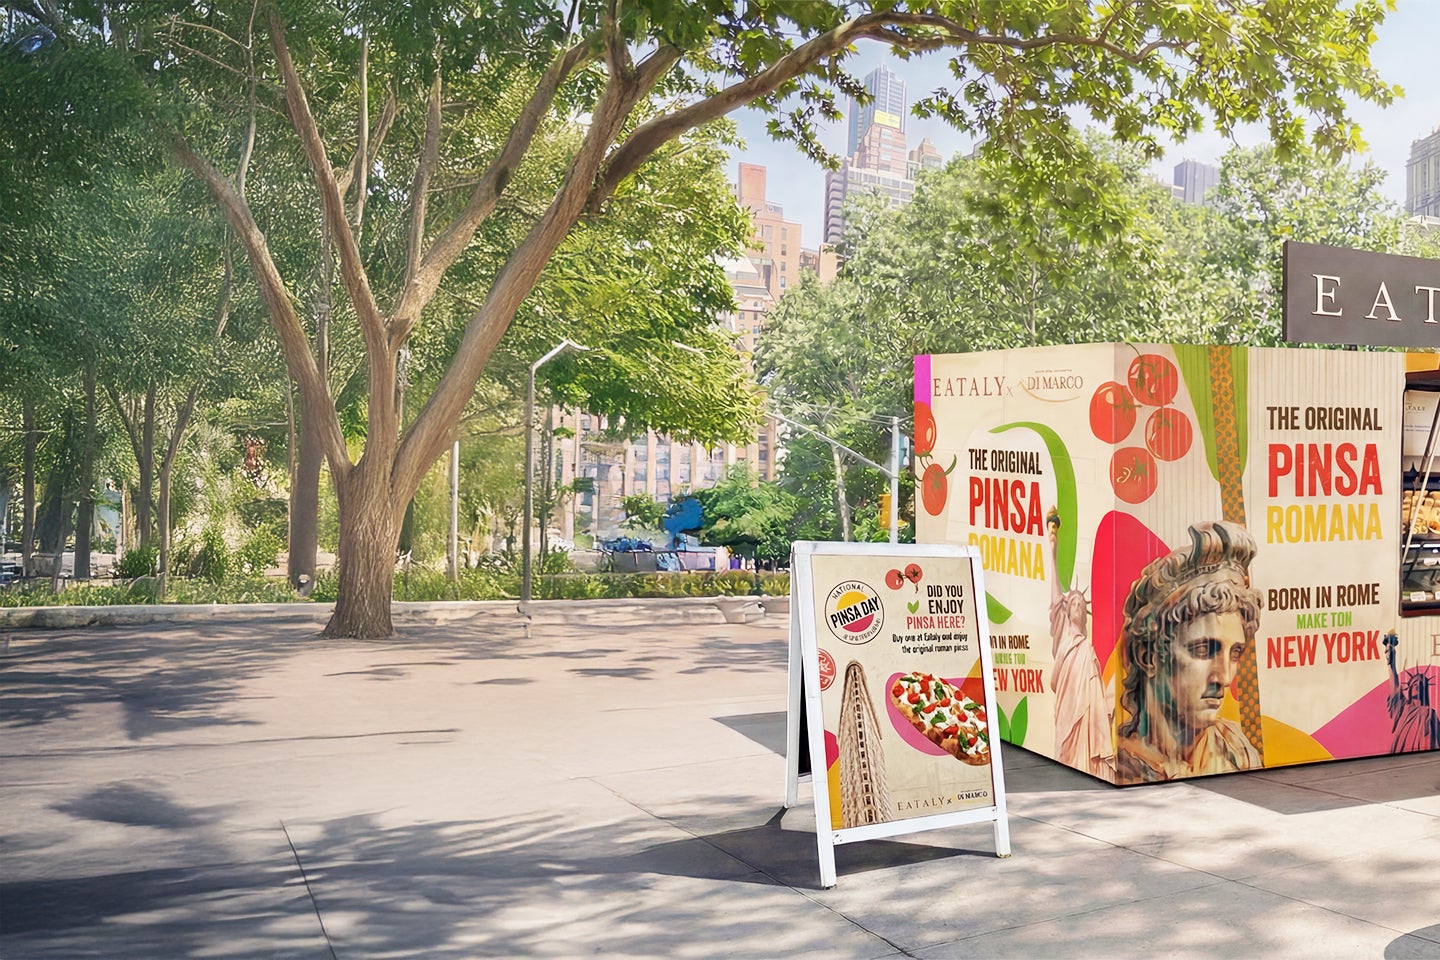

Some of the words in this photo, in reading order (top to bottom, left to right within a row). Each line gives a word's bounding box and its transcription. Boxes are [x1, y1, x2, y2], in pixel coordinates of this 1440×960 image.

[933, 376, 1006, 397] EATALY
[1043, 375, 1084, 390] MARCO
[1266, 406, 1300, 430] THE
[1305, 406, 1382, 431] ORIGINAL
[968, 448, 988, 470] THE
[990, 449, 1042, 475] ORIGINAL
[1268, 442, 1383, 497] PINSA
[969, 476, 1044, 536] PINSA
[1267, 503, 1383, 544] ROMANA
[927, 585, 943, 597] DID
[945, 585, 963, 597] YOU
[1268, 587, 1311, 611] BORN
[1316, 585, 1332, 609] IN
[1336, 583, 1380, 607] ROME
[830, 605, 862, 629] PINSA
[860, 596, 880, 616] DAY
[928, 599, 964, 614] ENJOY
[906, 615, 935, 630] PINSA
[937, 615, 966, 629] HERE?
[1296, 612, 1328, 629] MAKE
[998, 635, 1007, 650] IN
[1008, 634, 1030, 650] ROME
[1267, 634, 1319, 669] NEW
[1322, 630, 1381, 664] YORK
[1011, 668, 1044, 694] YORK
[897, 796, 945, 811] EATALY
